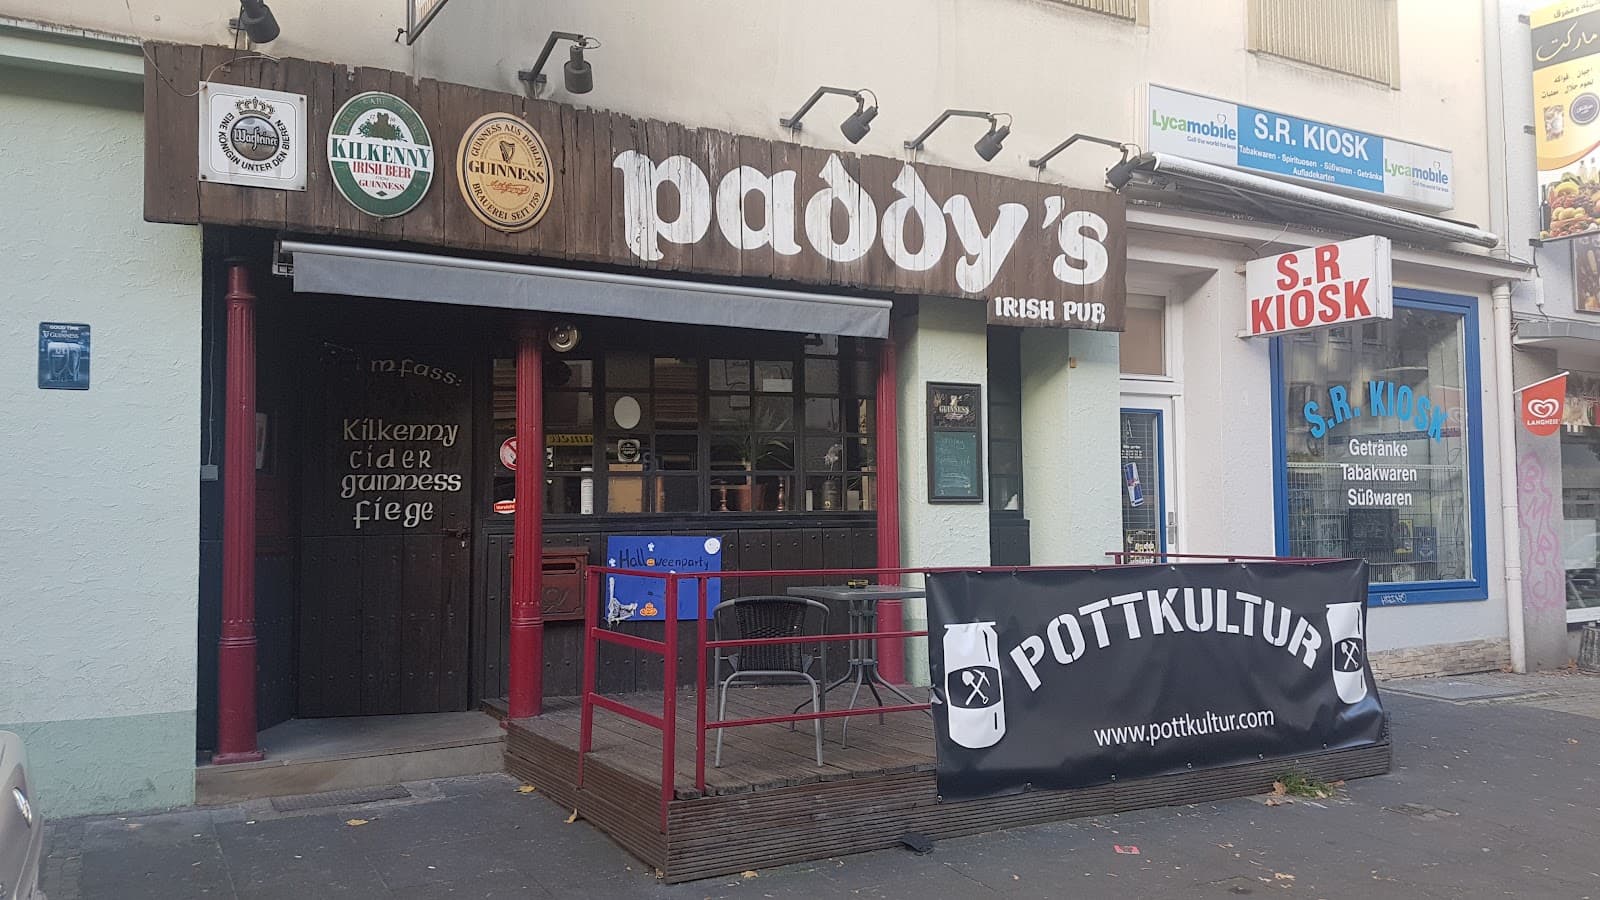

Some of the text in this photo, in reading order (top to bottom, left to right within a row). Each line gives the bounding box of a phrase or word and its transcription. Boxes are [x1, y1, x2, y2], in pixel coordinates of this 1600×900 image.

[1152, 110, 1237, 141] Lycamobile
[1254, 113, 1369, 161] S.R. KIOSK
[218, 112, 290, 172] EINE KÖNIGIN UNTER DEN BIEREN
[332, 138, 431, 168] KILKENNY
[471, 123, 544, 168] GUINNESS AUS DUBLIN
[353, 161, 411, 179] IRISH BEER
[468, 160, 545, 185] GUINNESS
[1239, 144, 1383, 181] Tabakwaren Spirituosen Süßwaren Getränke
[1292, 167, 1336, 182] Aufladekarten
[1384, 158, 1449, 185] Lycamobile
[359, 179, 405, 191] GUINNESS
[472, 183, 508, 220] BRAUEREI
[511, 207, 530, 221] SEIT
[529, 191, 541, 209] 1759
[612, 150, 1108, 293] paddy's
[1276, 244, 1341, 291] S.R
[995, 296, 1106, 323] IRISH PUB
[1251, 278, 1372, 335] KIOSK
[939, 405, 970, 415] GUINNESS
[1304, 380, 1448, 443] S.R. KIOSK
[343, 418, 459, 447] Kilkenny
[1349, 438, 1408, 457] Getränke
[341, 473, 462, 499] guinness
[1340, 463, 1417, 482] Tabakwaren
[1348, 488, 1412, 506] Süßwaren
[1009, 587, 1323, 692] POTTKULTUR
[1093, 707, 1275, 747] www.pottkultur.com
